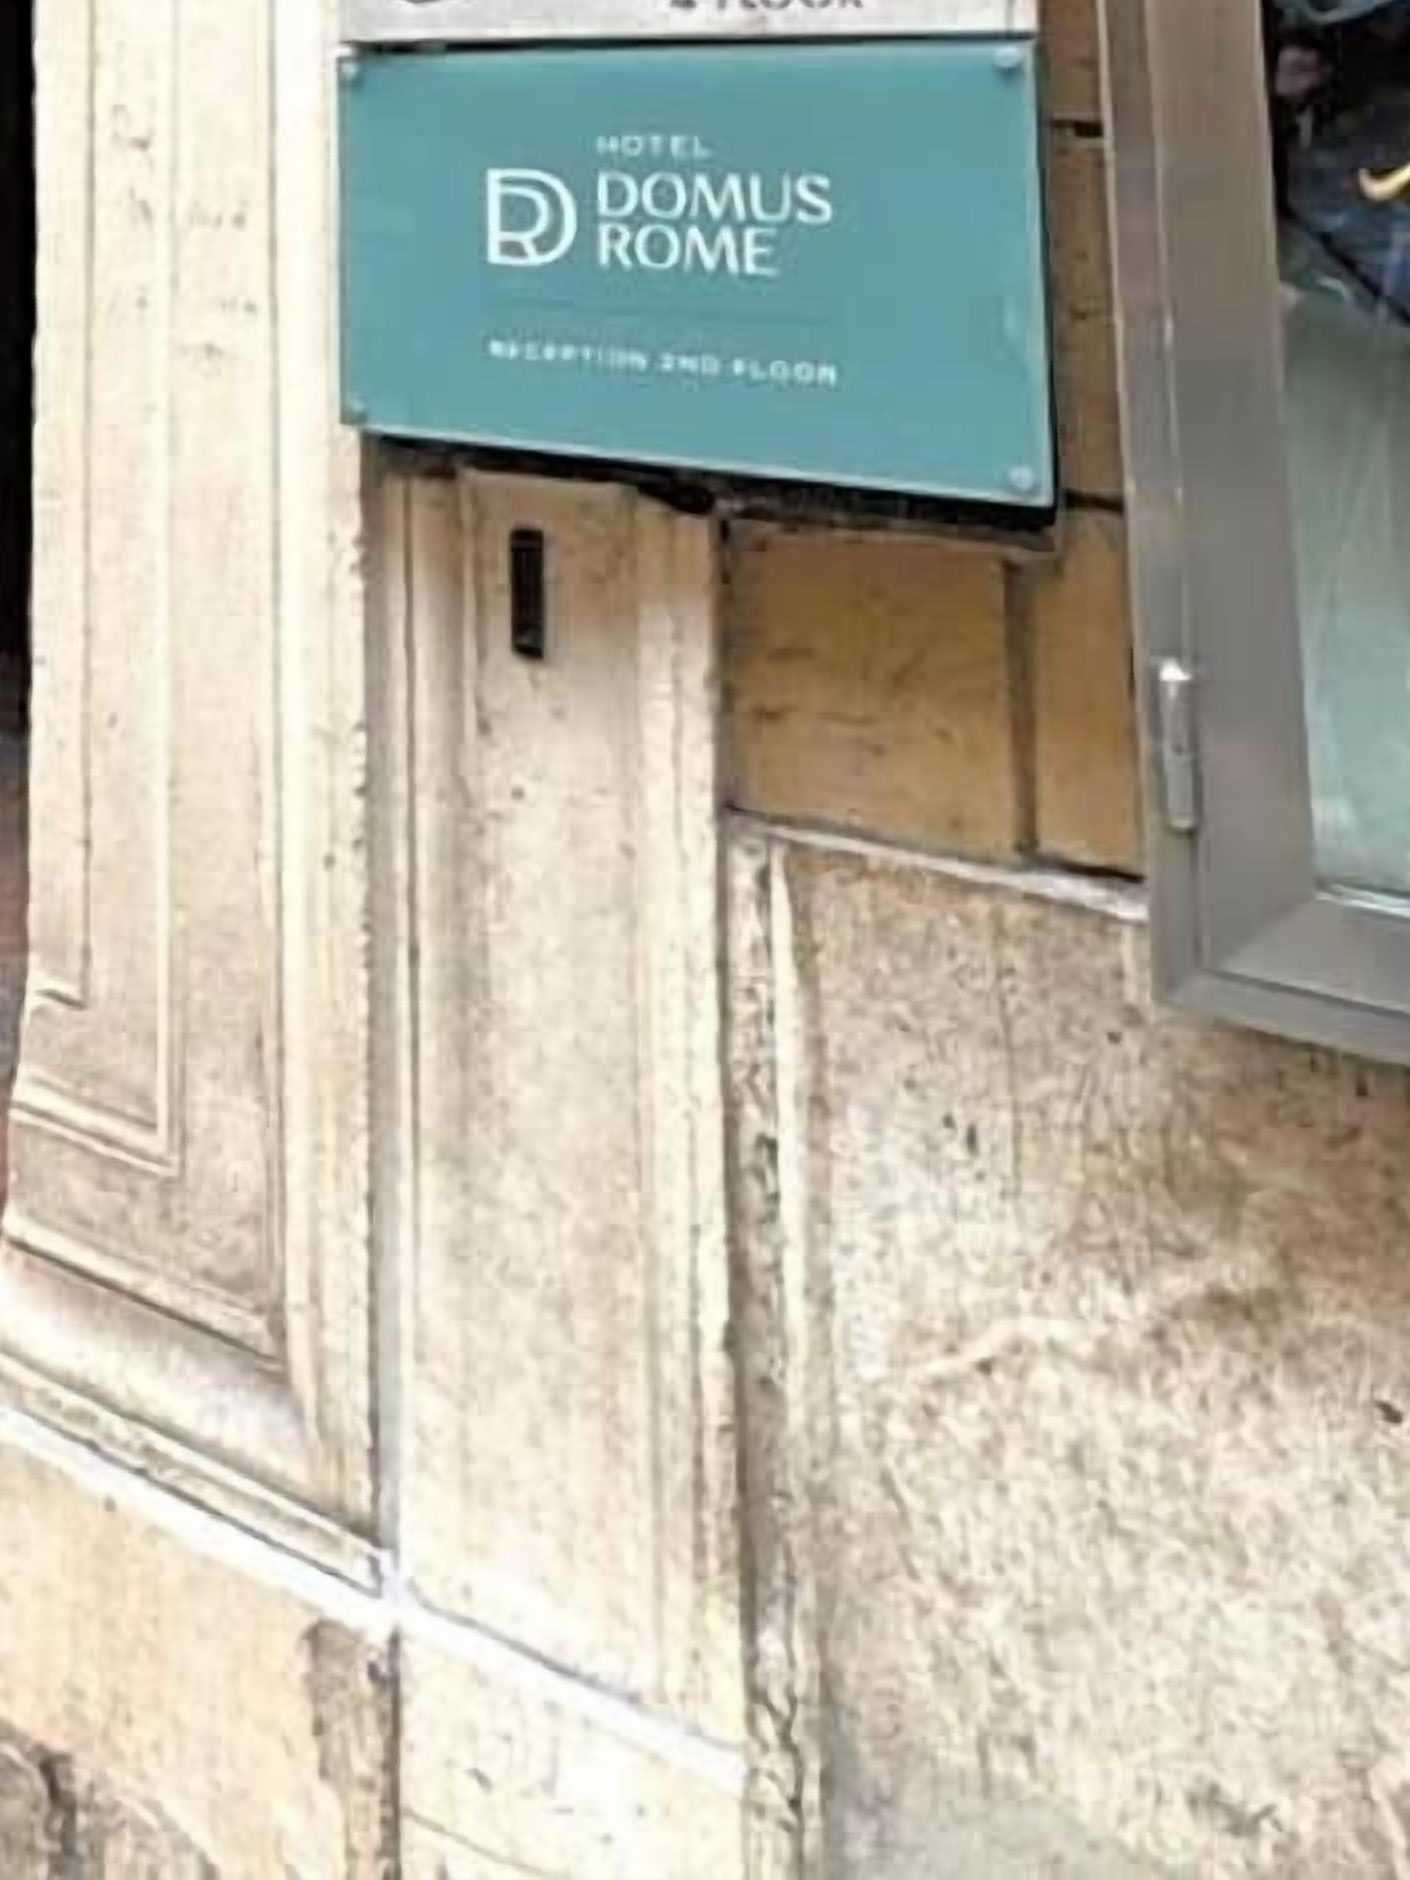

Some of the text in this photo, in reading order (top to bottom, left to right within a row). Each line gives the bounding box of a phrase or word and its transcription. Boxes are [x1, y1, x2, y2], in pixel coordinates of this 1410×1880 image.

[595, 134, 715, 160] HOTEL
[597, 170, 834, 224] DOMUS
[598, 221, 782, 277] ROME
[489, 339, 649, 372] RECEPTION
[731, 357, 838, 387] FLOOR
